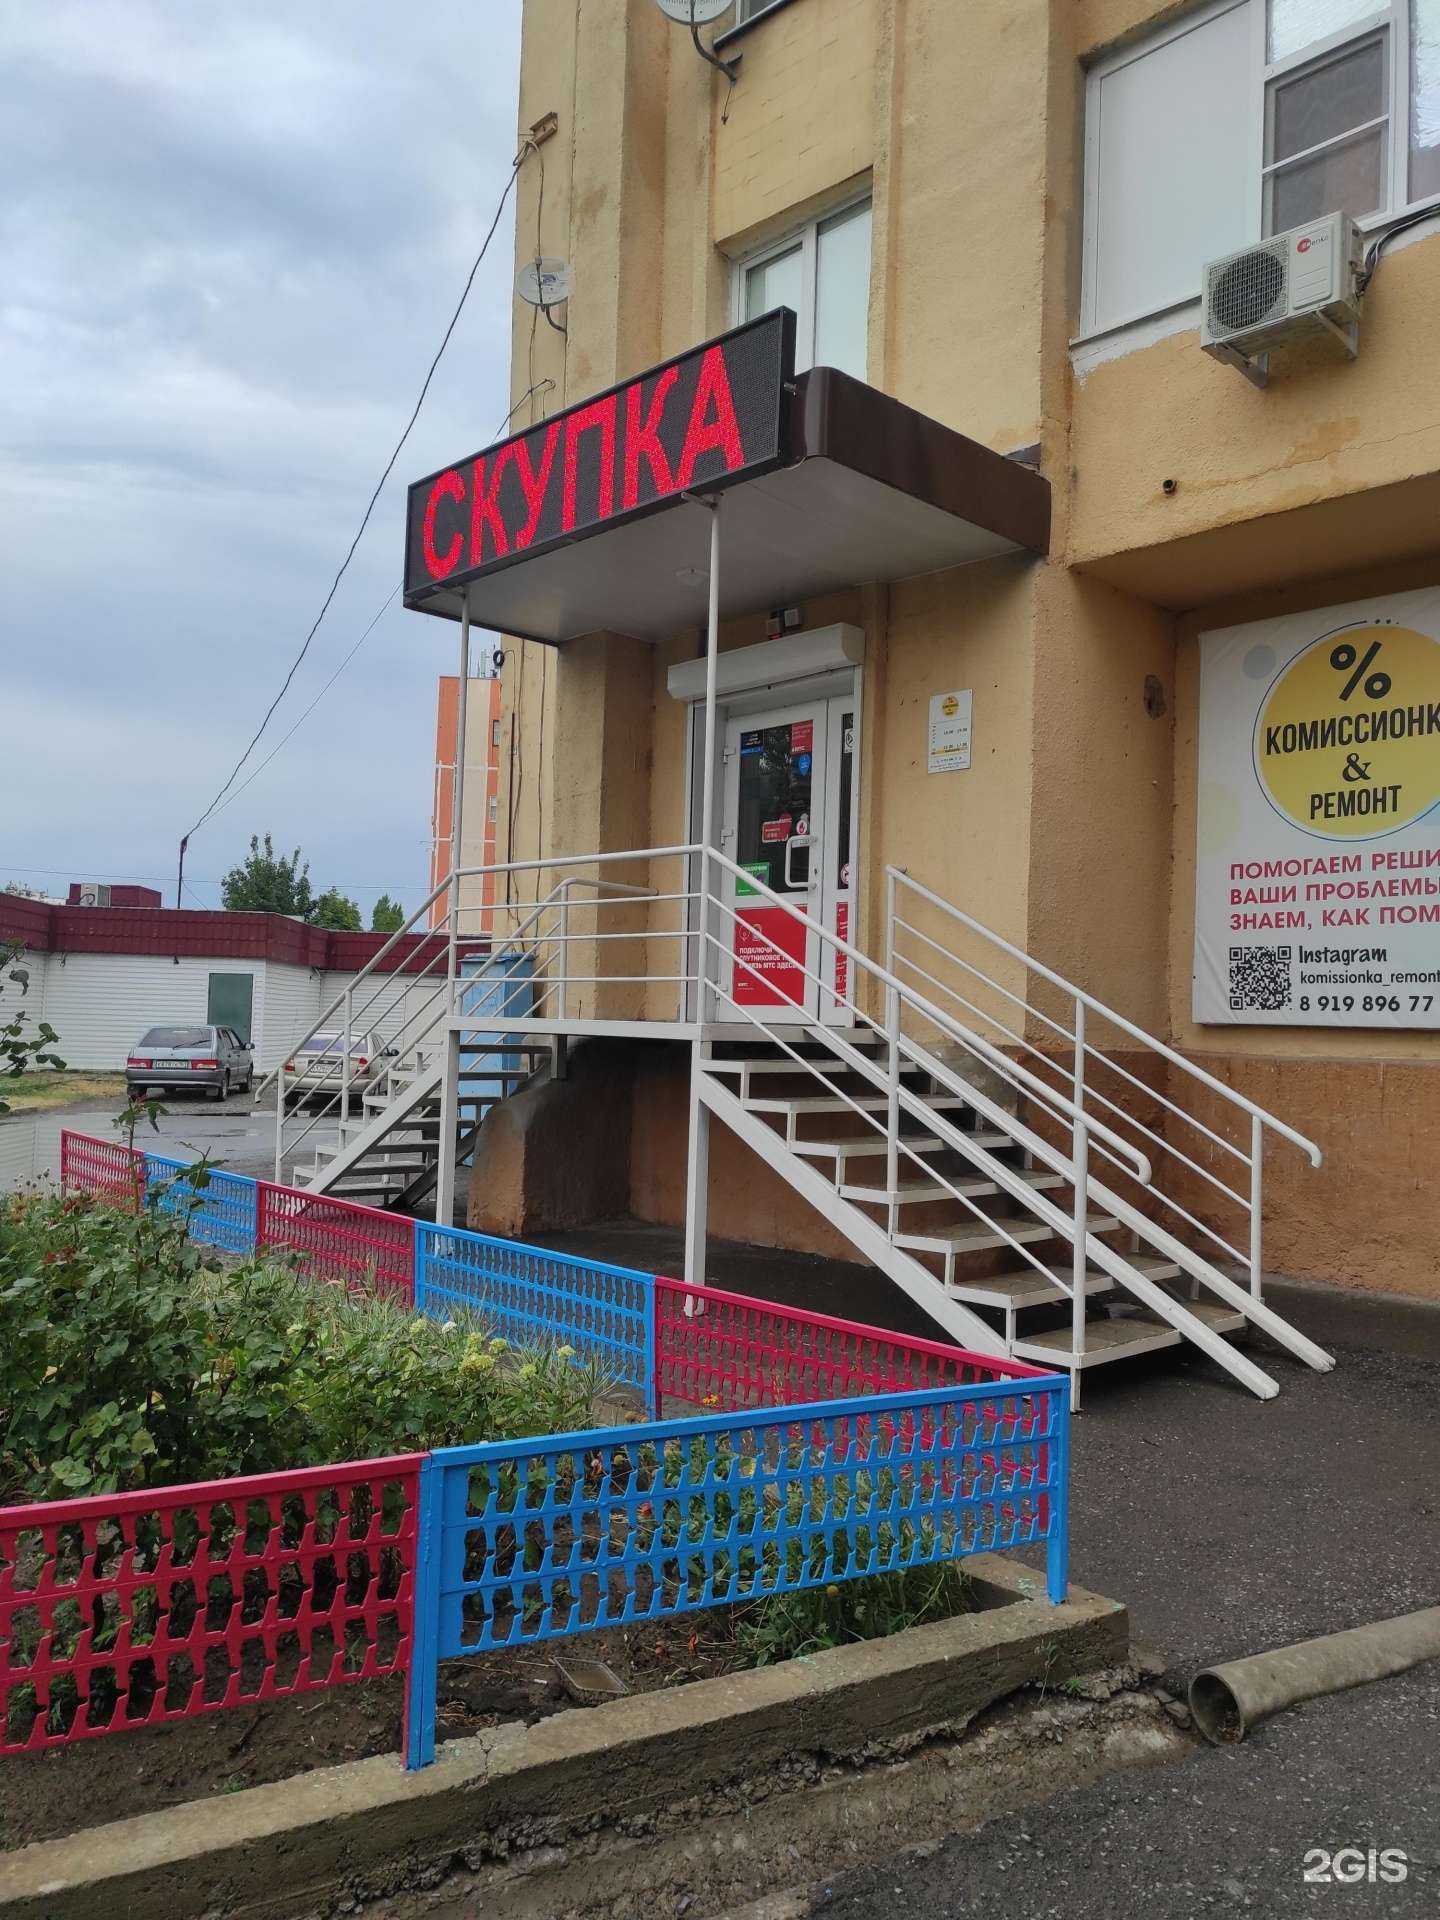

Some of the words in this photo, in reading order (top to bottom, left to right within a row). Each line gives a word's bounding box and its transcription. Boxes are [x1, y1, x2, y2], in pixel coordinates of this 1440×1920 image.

[423, 345, 745, 580] СКУПКА
[1342, 753, 1372, 782] &
[1310, 785, 1402, 819] РЕМОНТ
[1230, 855, 1362, 880] ПОМОГАЕМ
[1230, 886, 1297, 905] ВАШИ
[1230, 911, 1312, 931] ЗНАЕМ,
[1322, 908, 1370, 926] КАК
[1299, 945, 1387, 966] Instagram
[1299, 996, 1310, 1012] 8
[1317, 996, 1355, 1012] 919
[1362, 996, 1400, 1012] 896
[1409, 996, 1434, 1012] 77
